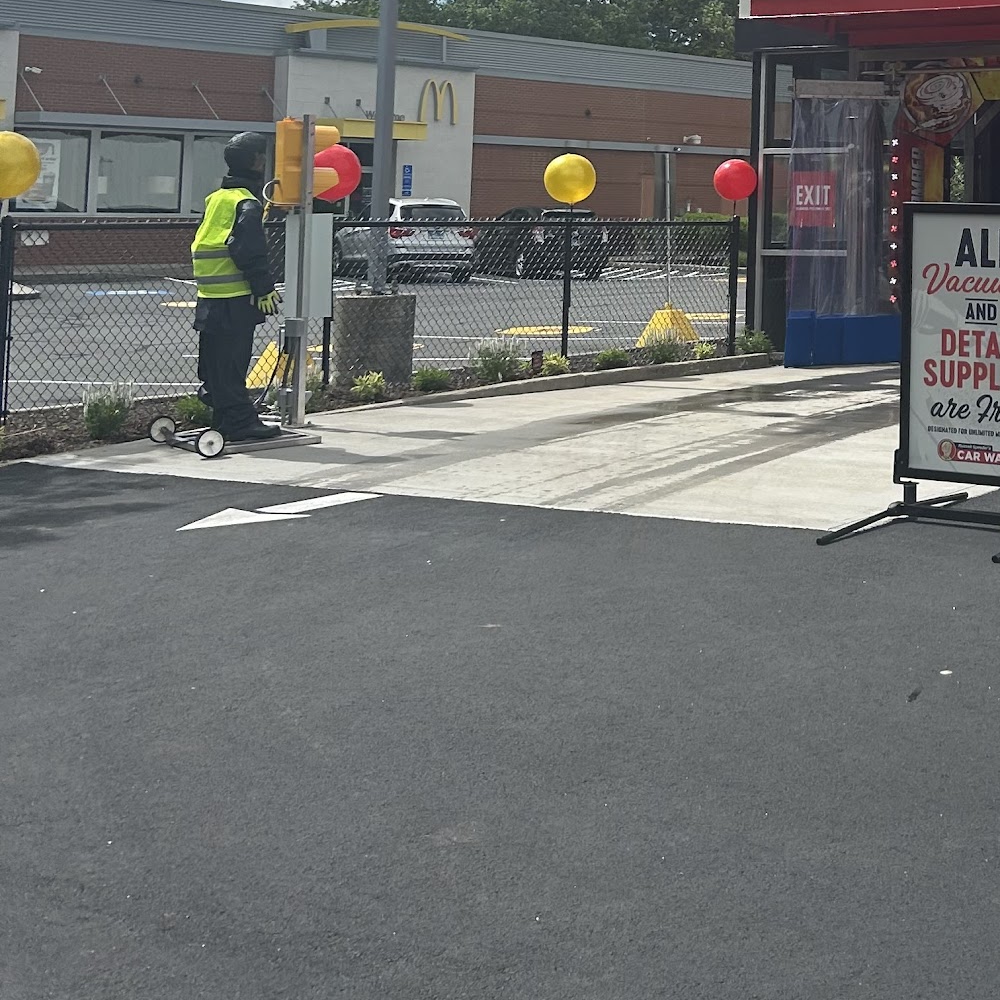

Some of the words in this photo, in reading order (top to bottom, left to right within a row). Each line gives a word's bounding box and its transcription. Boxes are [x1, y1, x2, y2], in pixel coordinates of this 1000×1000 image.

[796, 184, 831, 206] EXIT
[965, 302, 997, 321] AND
[930, 398, 971, 419] are
[927, 425, 958, 434] DESIGNATED
[968, 428, 995, 437] UNLIMITED
[957, 450, 981, 461] CAR
